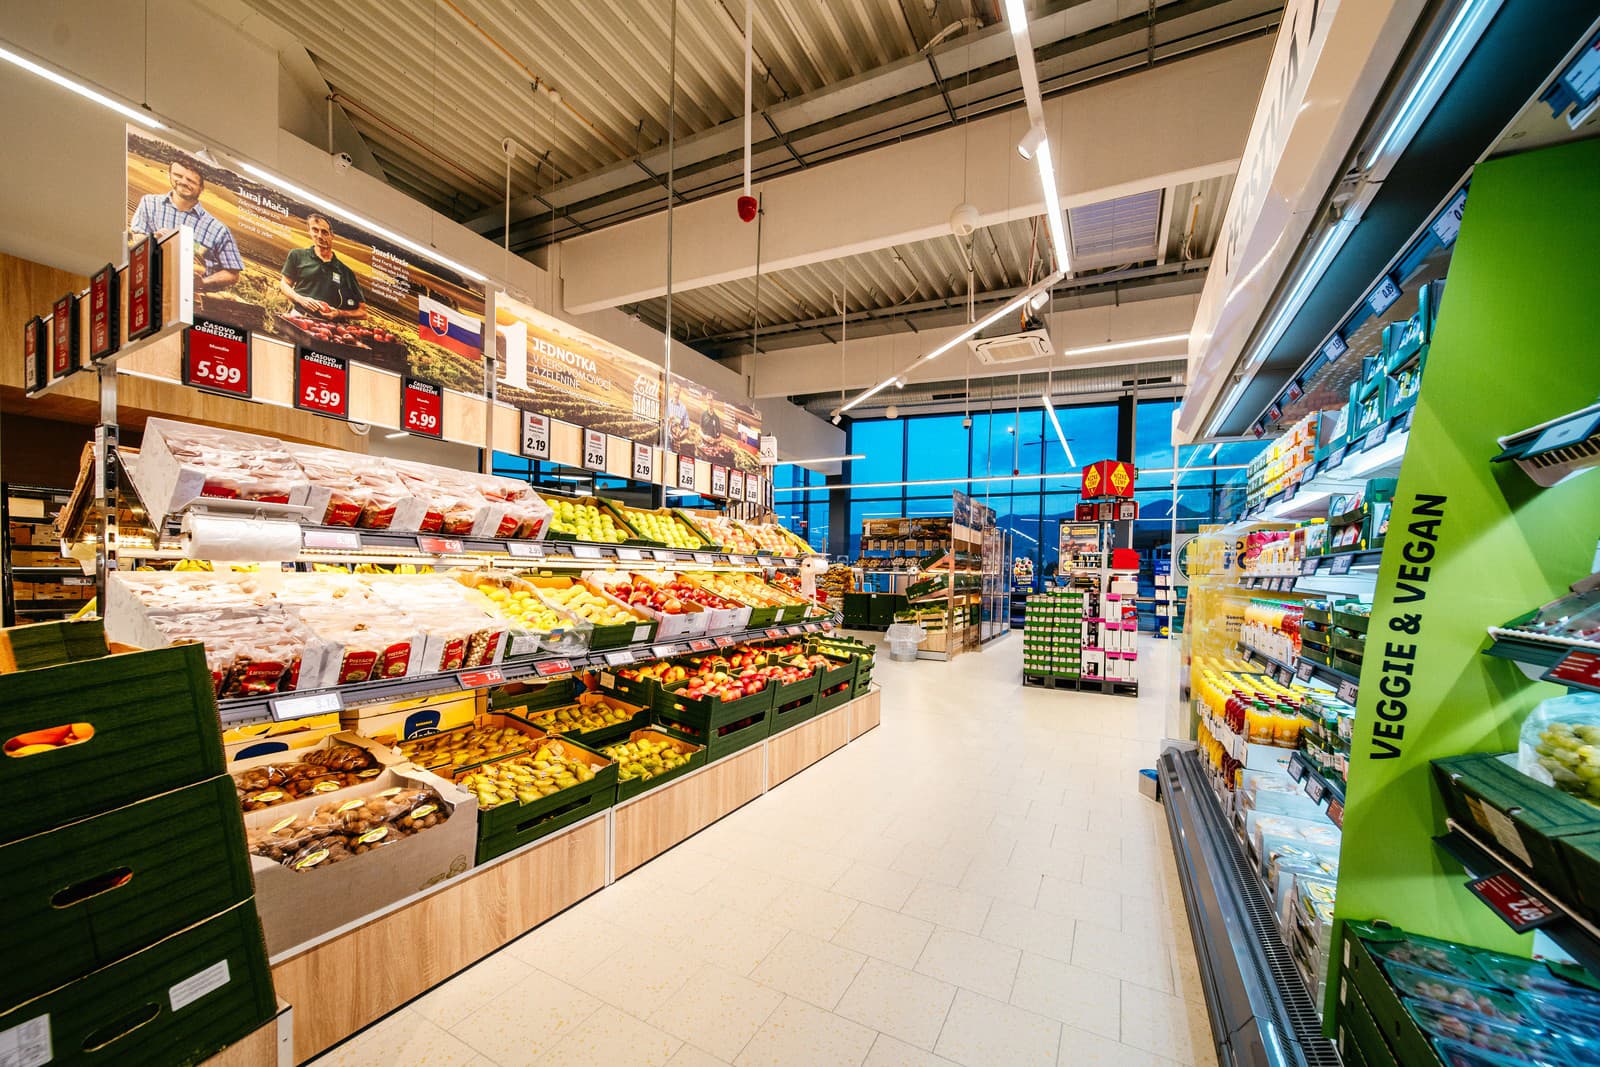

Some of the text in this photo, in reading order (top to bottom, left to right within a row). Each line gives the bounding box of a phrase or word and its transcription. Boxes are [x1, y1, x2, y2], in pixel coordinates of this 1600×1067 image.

[238, 186, 289, 217] Juraj Mačaj
[203, 321, 236, 335] ČASOVO
[311, 352, 337, 363] ČASOVO
[532, 337, 597, 374] JEDNOTKA
[533, 353, 539, 363] V
[196, 360, 241, 384] 5.99
[532, 365, 581, 389] A ZELENINE
[305, 386, 341, 407] 5.99
[409, 411, 437, 428] 5.99
[527, 437, 546, 451] 2.19
[587, 453, 604, 465] 2.19
[637, 464, 650, 475] 2.19
[1370, 494, 1448, 760] VEGGIE & VEGAN
[1508, 899, 1545, 921] 2.49
